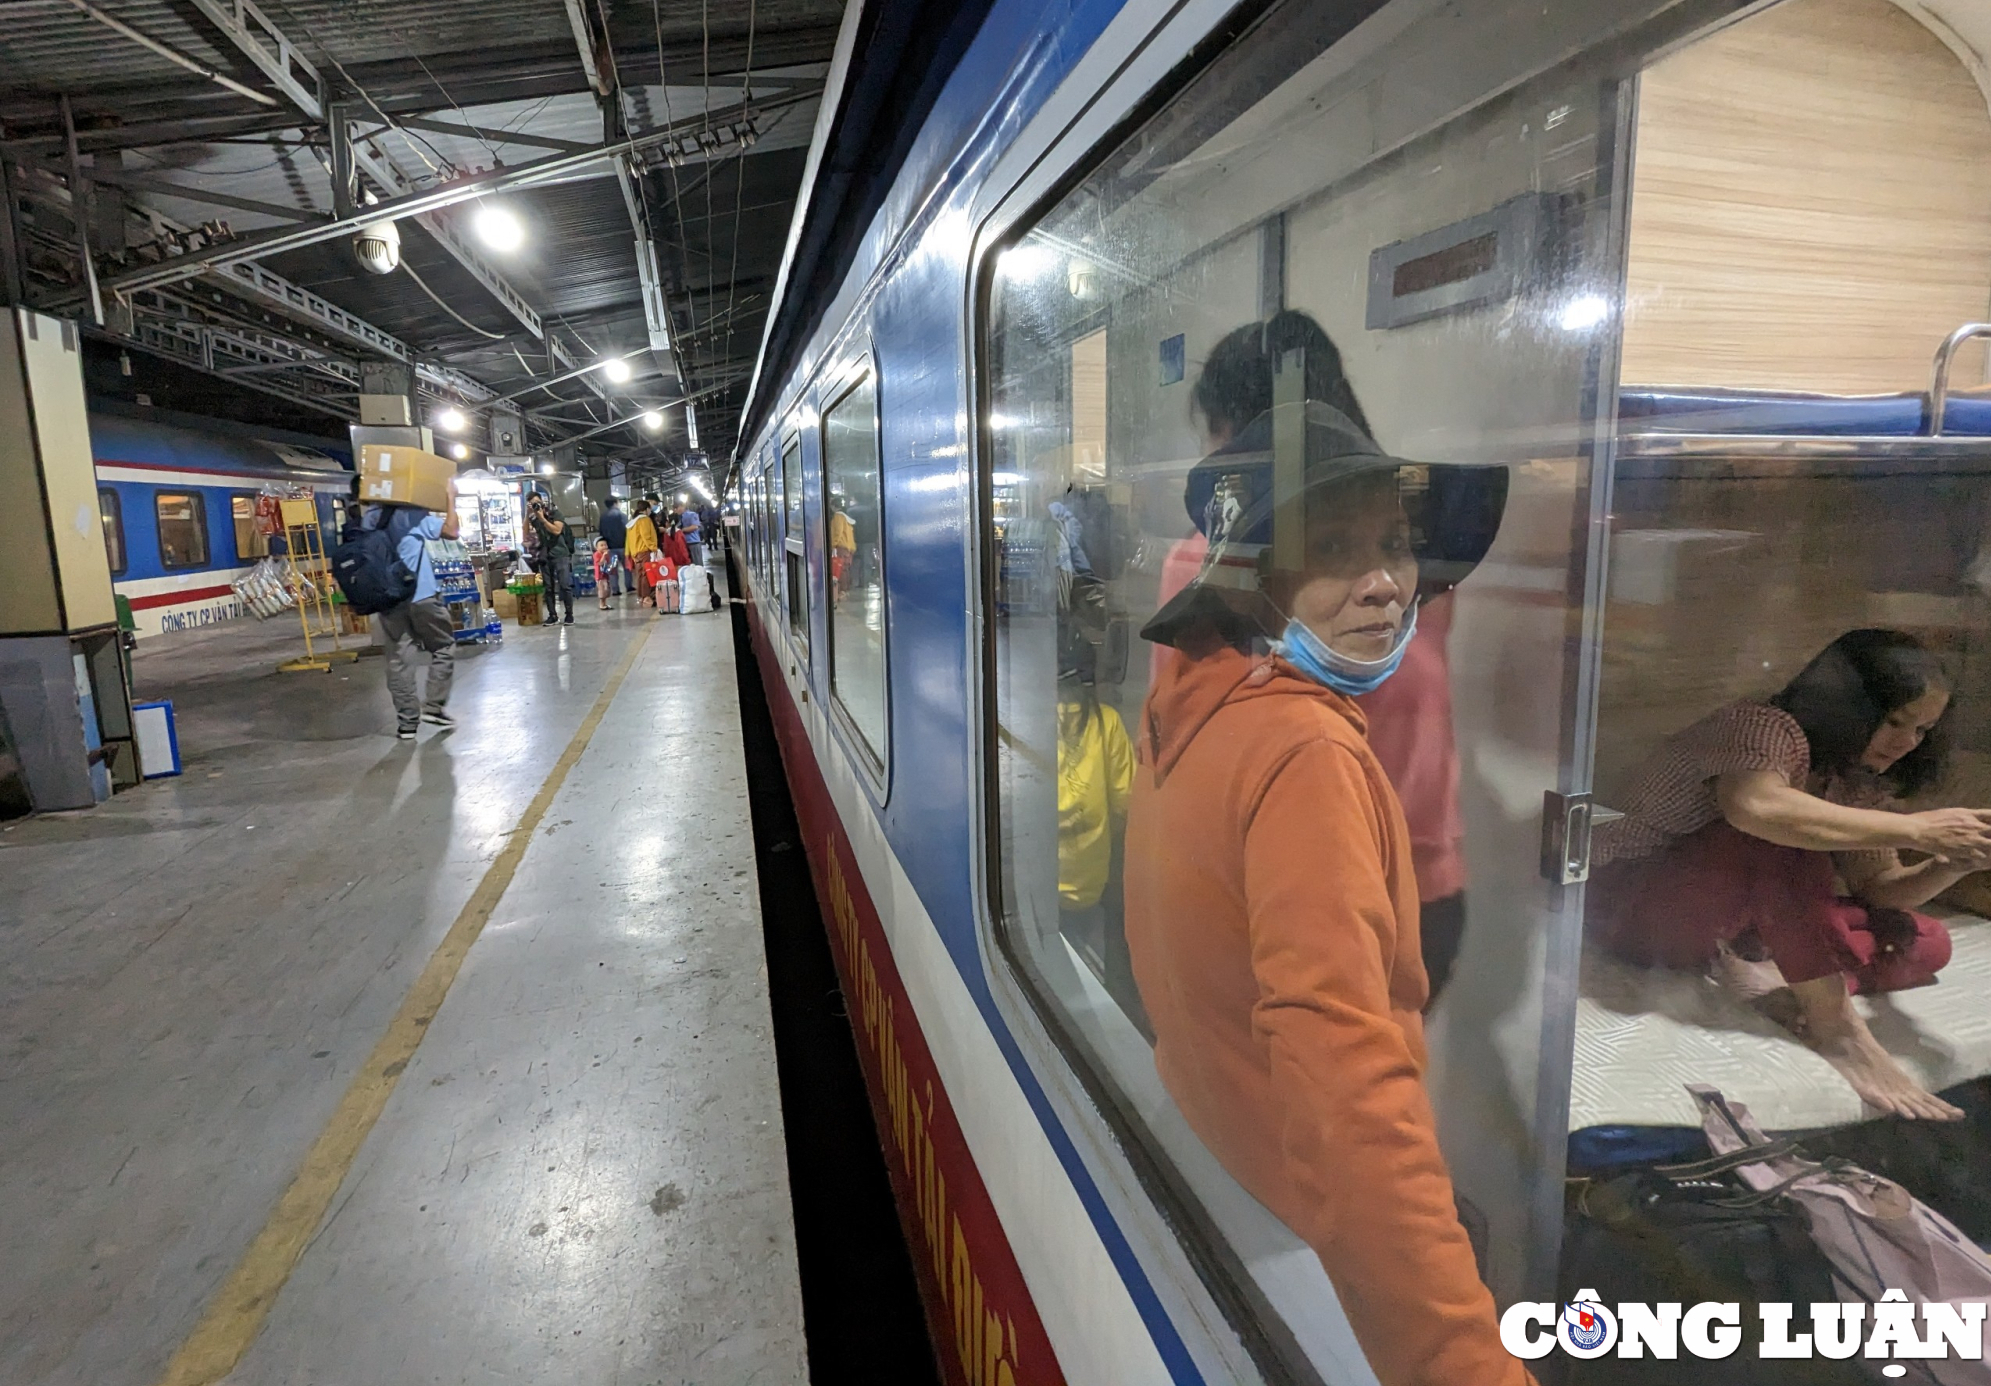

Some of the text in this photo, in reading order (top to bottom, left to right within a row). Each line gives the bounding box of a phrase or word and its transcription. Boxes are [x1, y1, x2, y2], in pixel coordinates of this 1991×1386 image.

[162, 610, 185, 633] CÔNG
[187, 610, 197, 628] TY
[200, 607, 210, 626] CP
[911, 1079, 949, 1309] TẢI
